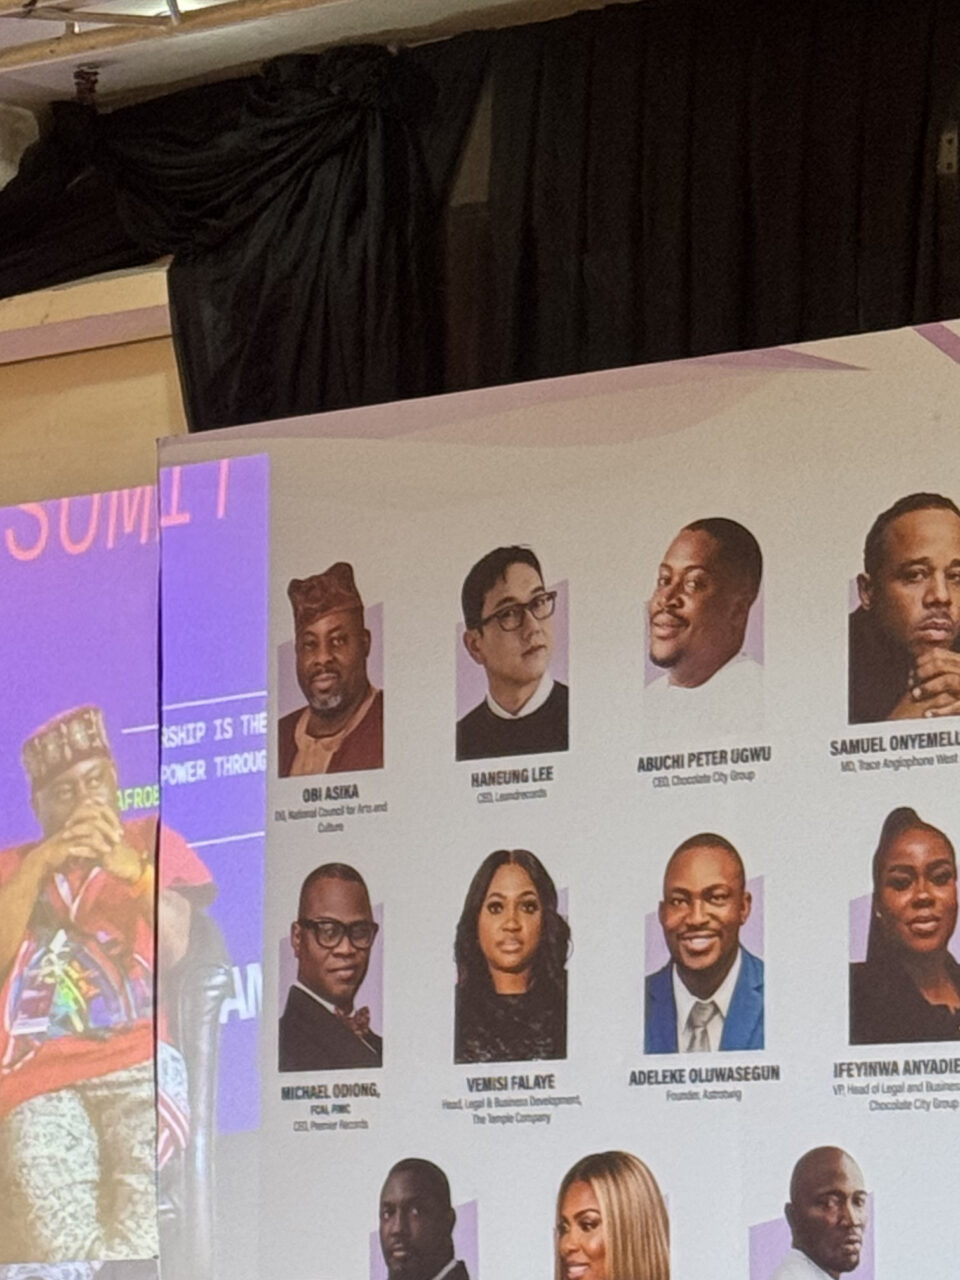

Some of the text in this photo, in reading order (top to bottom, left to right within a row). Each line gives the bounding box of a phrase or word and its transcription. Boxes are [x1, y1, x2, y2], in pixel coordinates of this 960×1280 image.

[213, 717, 234, 741] IS
[240, 712, 267, 736] THE
[830, 736, 887, 756] SAMUEL
[637, 746, 772, 772] ABUCHI PETER UGWU
[936, 753, 958, 765] West
[161, 759, 207, 786] POWER
[471, 766, 554, 788] HANEUNG LEE
[672, 774, 711, 786] Chocolate
[713, 771, 728, 784] City
[730, 770, 755, 782] Group
[302, 784, 359, 803] OBI ASIKA
[318, 805, 344, 817] Council
[346, 804, 356, 815] for
[357, 803, 372, 814] Arts
[373, 801, 388, 813] and
[629, 1065, 780, 1086] ADELEKE OLUWASEGUN
[833, 1061, 900, 1079] IFEYINWA
[511, 1074, 556, 1091] FALAYE
[847, 1083, 869, 1095] Head
[871, 1082, 880, 1095] of
[881, 1081, 905, 1096] Legal
[907, 1081, 923, 1093] and
[281, 1084, 331, 1101] MICHAEL
[869, 1097, 960, 1111] Chocolate City Group
[473, 1113, 486, 1124] The
[515, 1112, 551, 1124] Company
